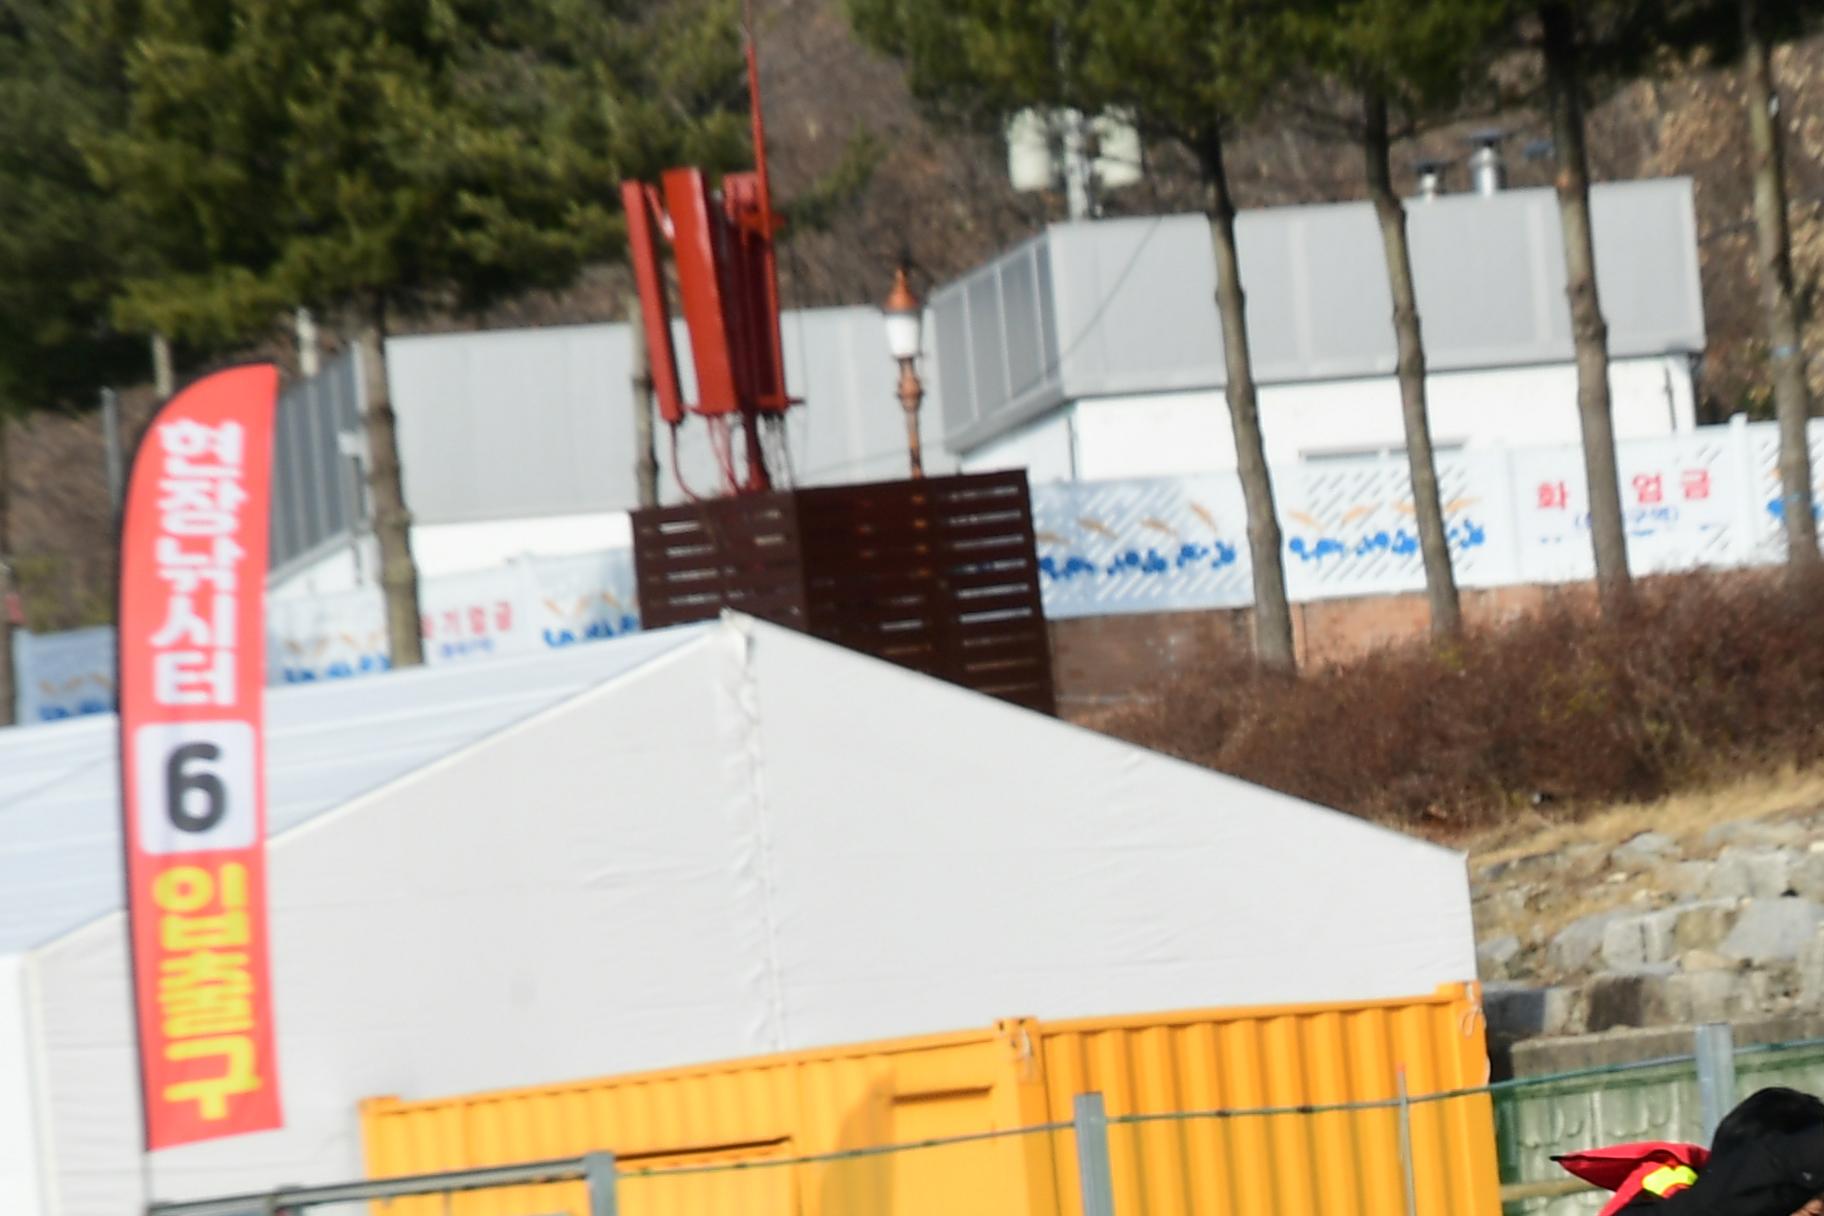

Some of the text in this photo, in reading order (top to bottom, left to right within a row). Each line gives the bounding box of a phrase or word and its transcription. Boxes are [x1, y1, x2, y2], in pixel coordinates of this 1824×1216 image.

[151, 418, 262, 1121] 현장낚시터 6 입출구
